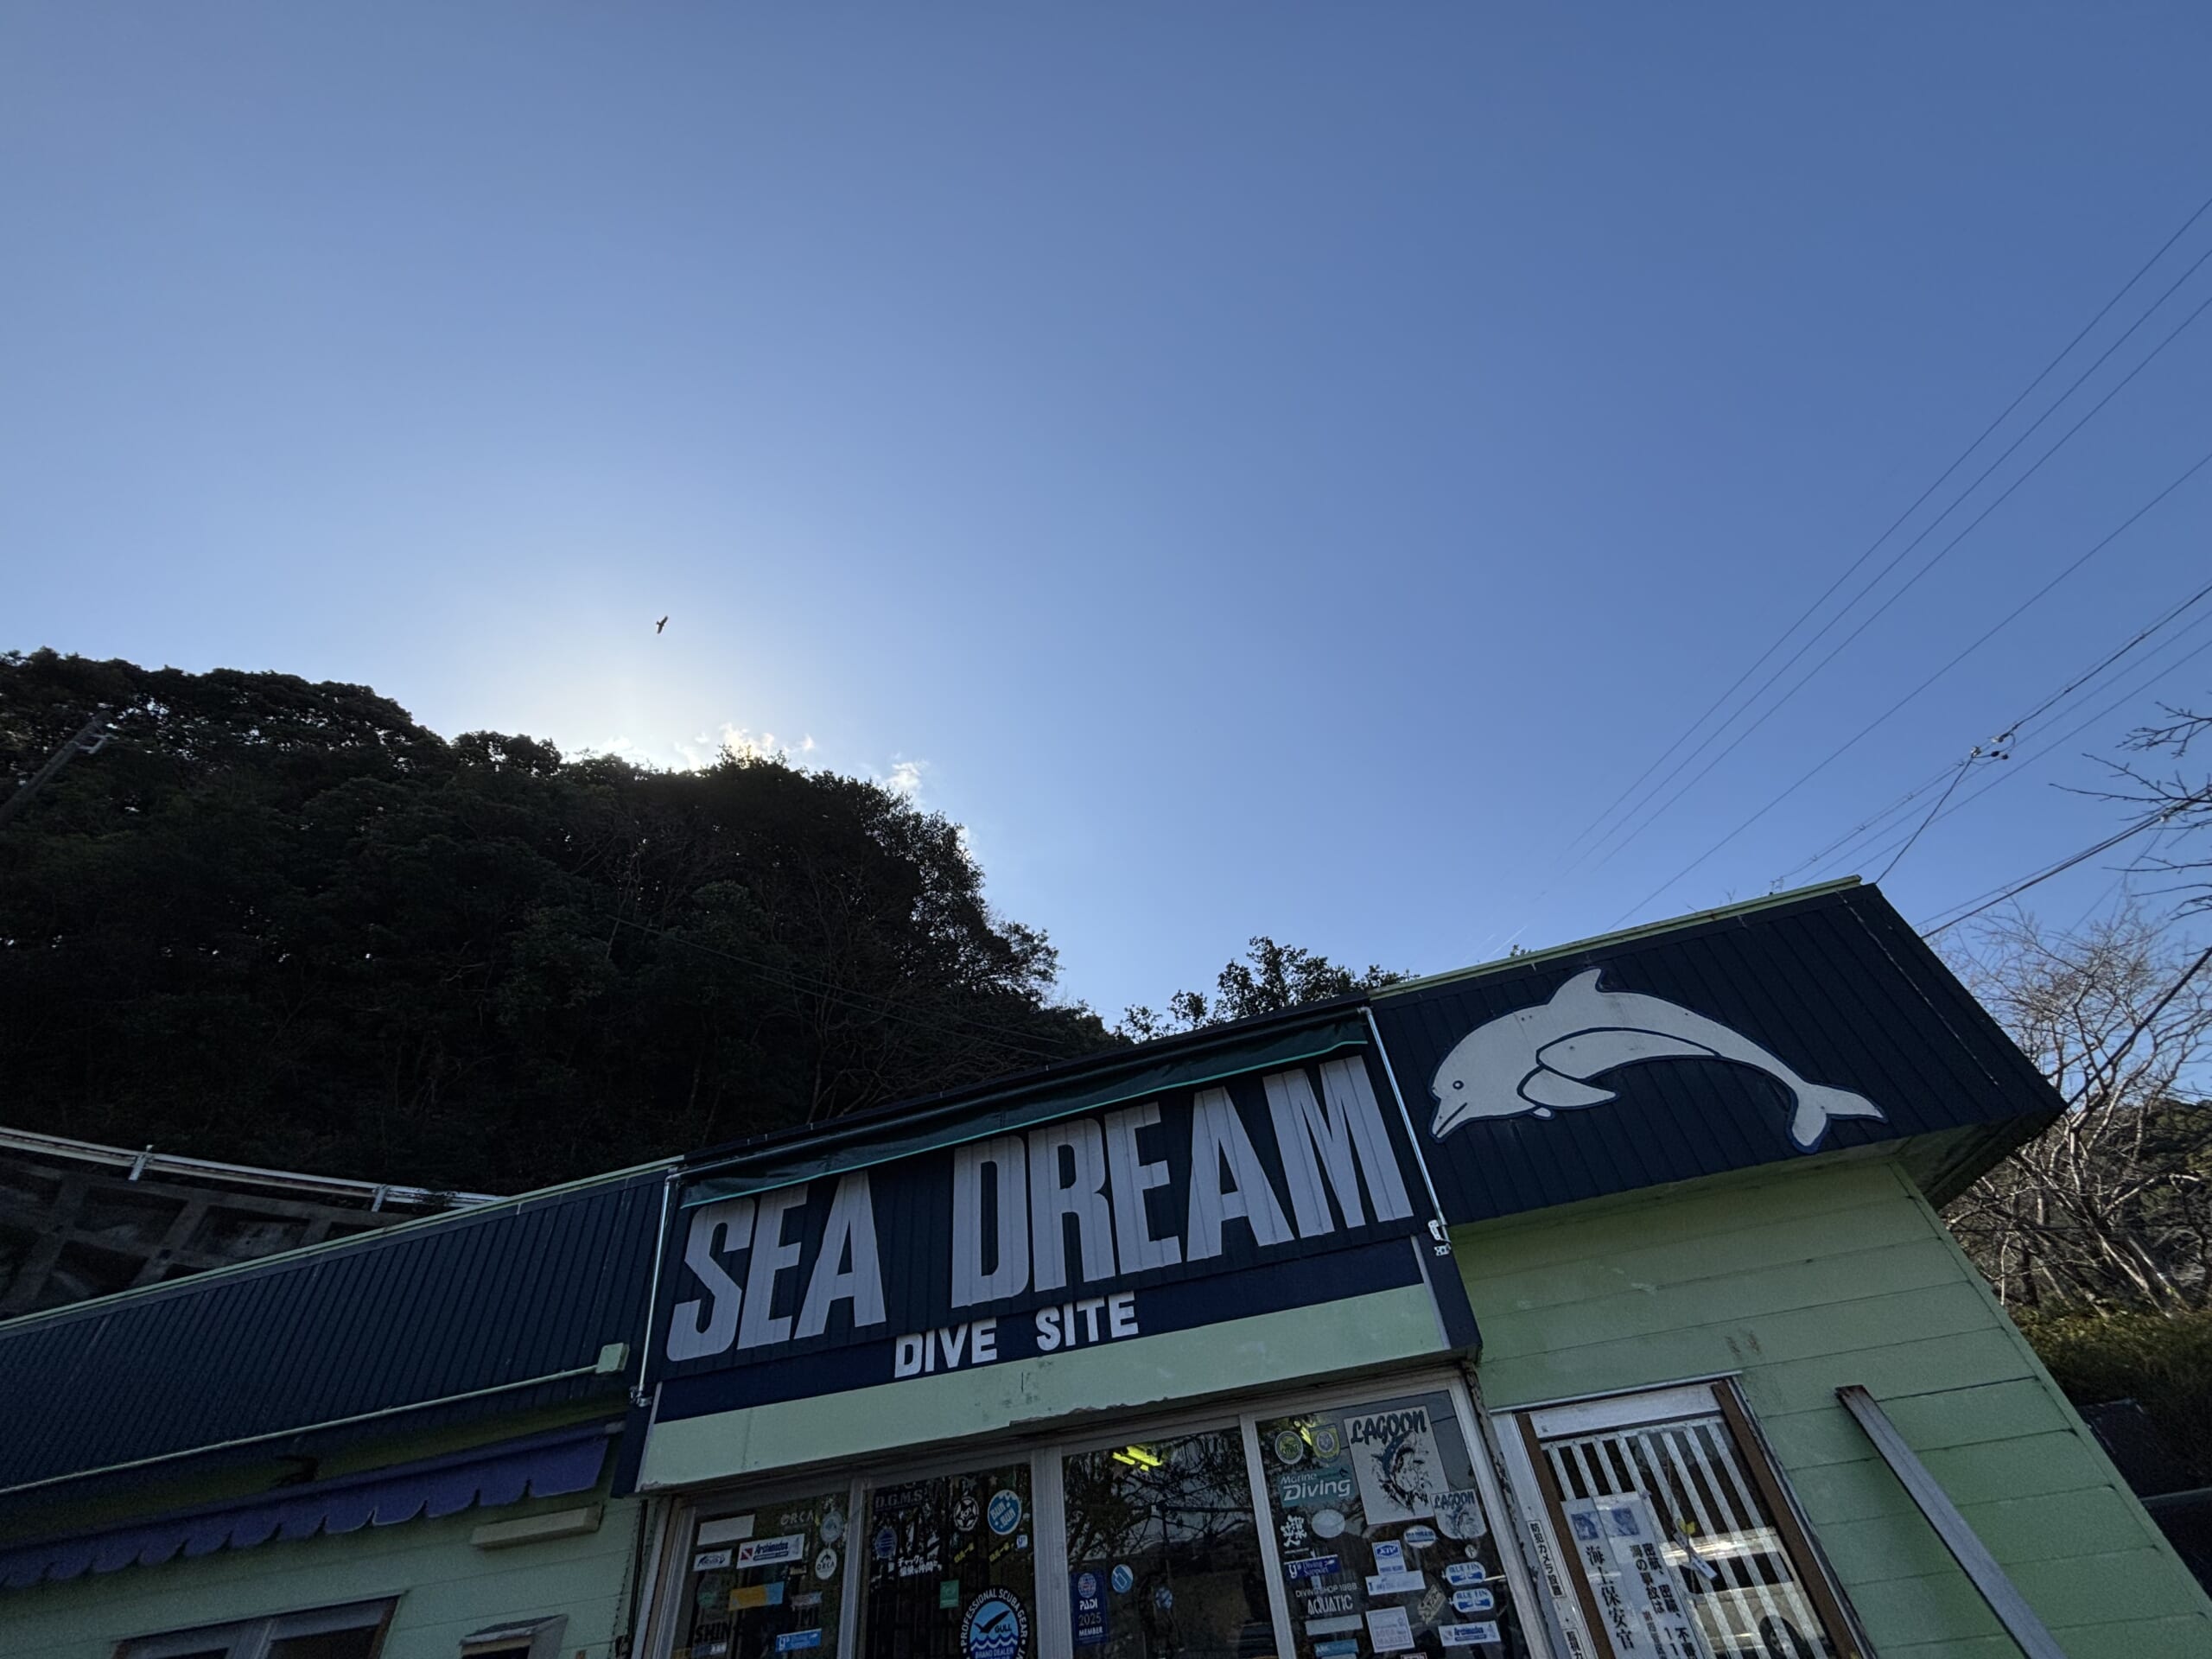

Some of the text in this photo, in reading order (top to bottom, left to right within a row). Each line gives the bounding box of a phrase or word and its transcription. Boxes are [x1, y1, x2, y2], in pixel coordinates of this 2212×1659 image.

[666, 1055, 1414, 1361] SEA DREAM
[894, 1291, 1140, 1378] DIVE SITE
[1351, 1411, 1427, 1445] LAGOON
[1280, 1472, 1317, 1484] Marine
[1283, 1479, 1351, 1501] Diving
[1079, 1598, 1098, 1611] PADI
[1307, 1594, 1354, 1616] AQUATIC
[1585, 1546, 1635, 1650] 海上保安官
[960, 1588, 1028, 1647] PROFESSIONAL SCUBA GEAR
[995, 1624, 1013, 1633] GULL
[1078, 1611, 1103, 1627] 2025
[1078, 1626, 1104, 1637] MEMBER
